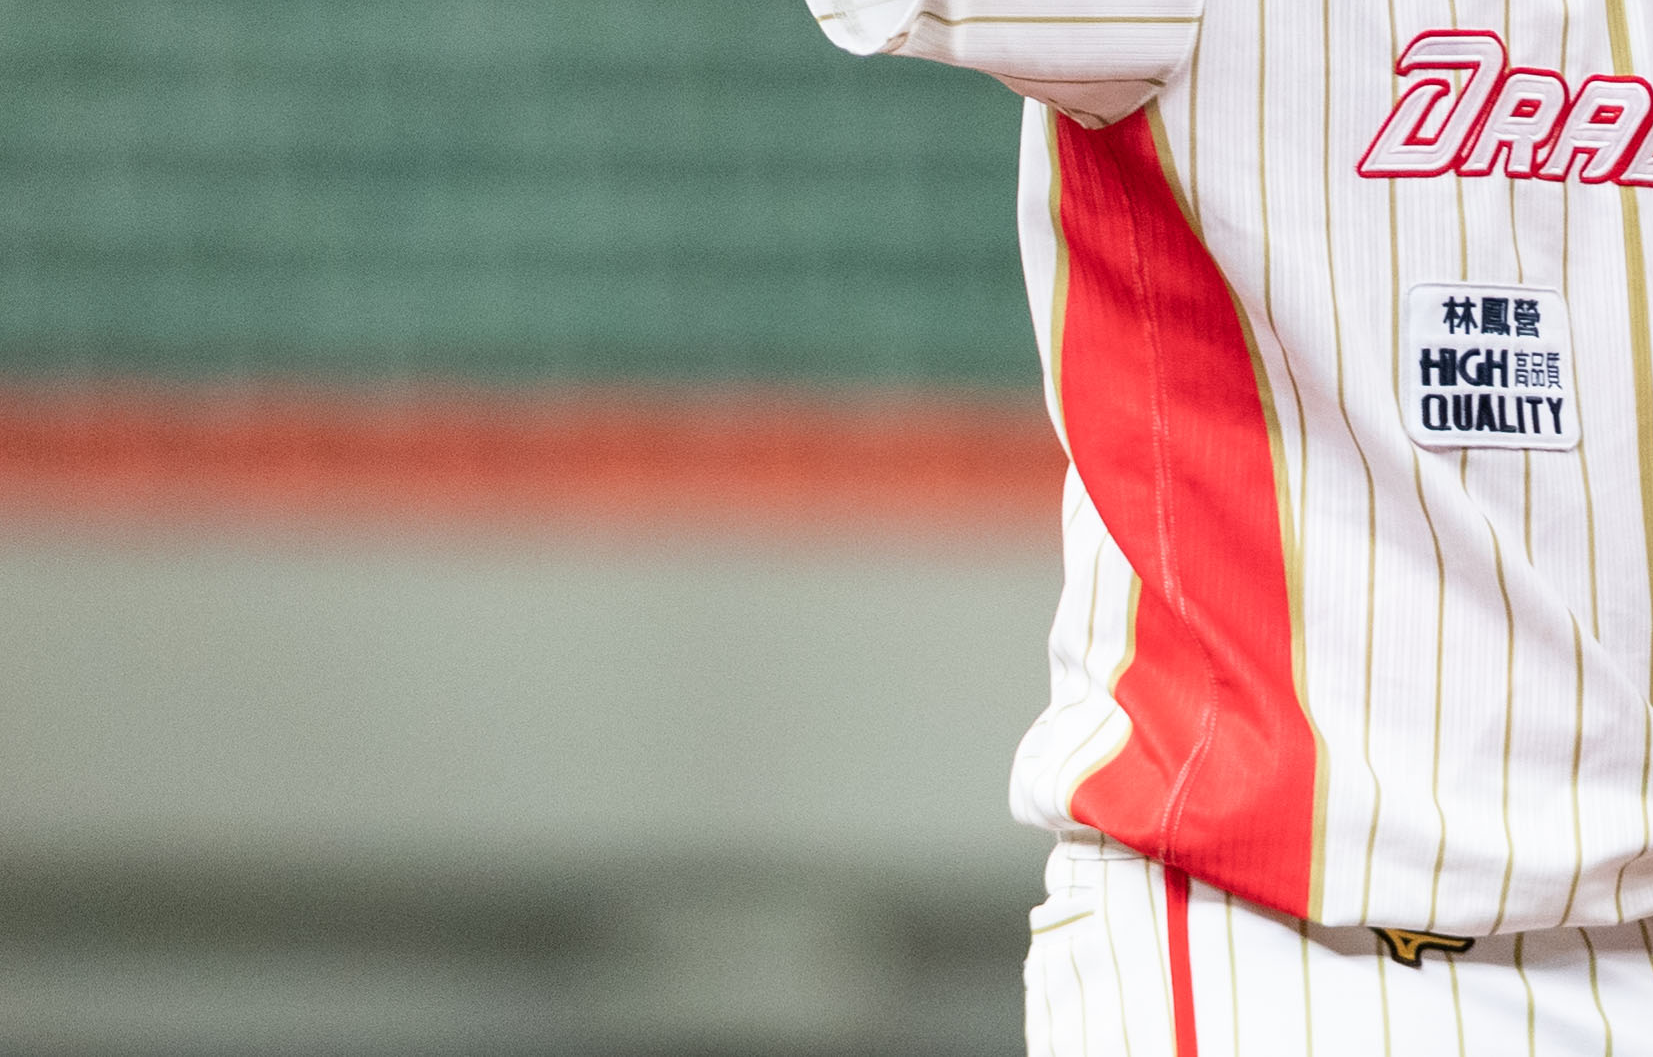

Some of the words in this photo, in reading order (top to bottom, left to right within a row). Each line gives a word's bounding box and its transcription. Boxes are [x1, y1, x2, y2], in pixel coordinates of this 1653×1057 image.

[1442, 296, 1541, 338] 林鳳營
[1419, 348, 1509, 388] HIGH
[1514, 350, 1562, 389] 高品質
[1421, 393, 1563, 434] QUALITY
